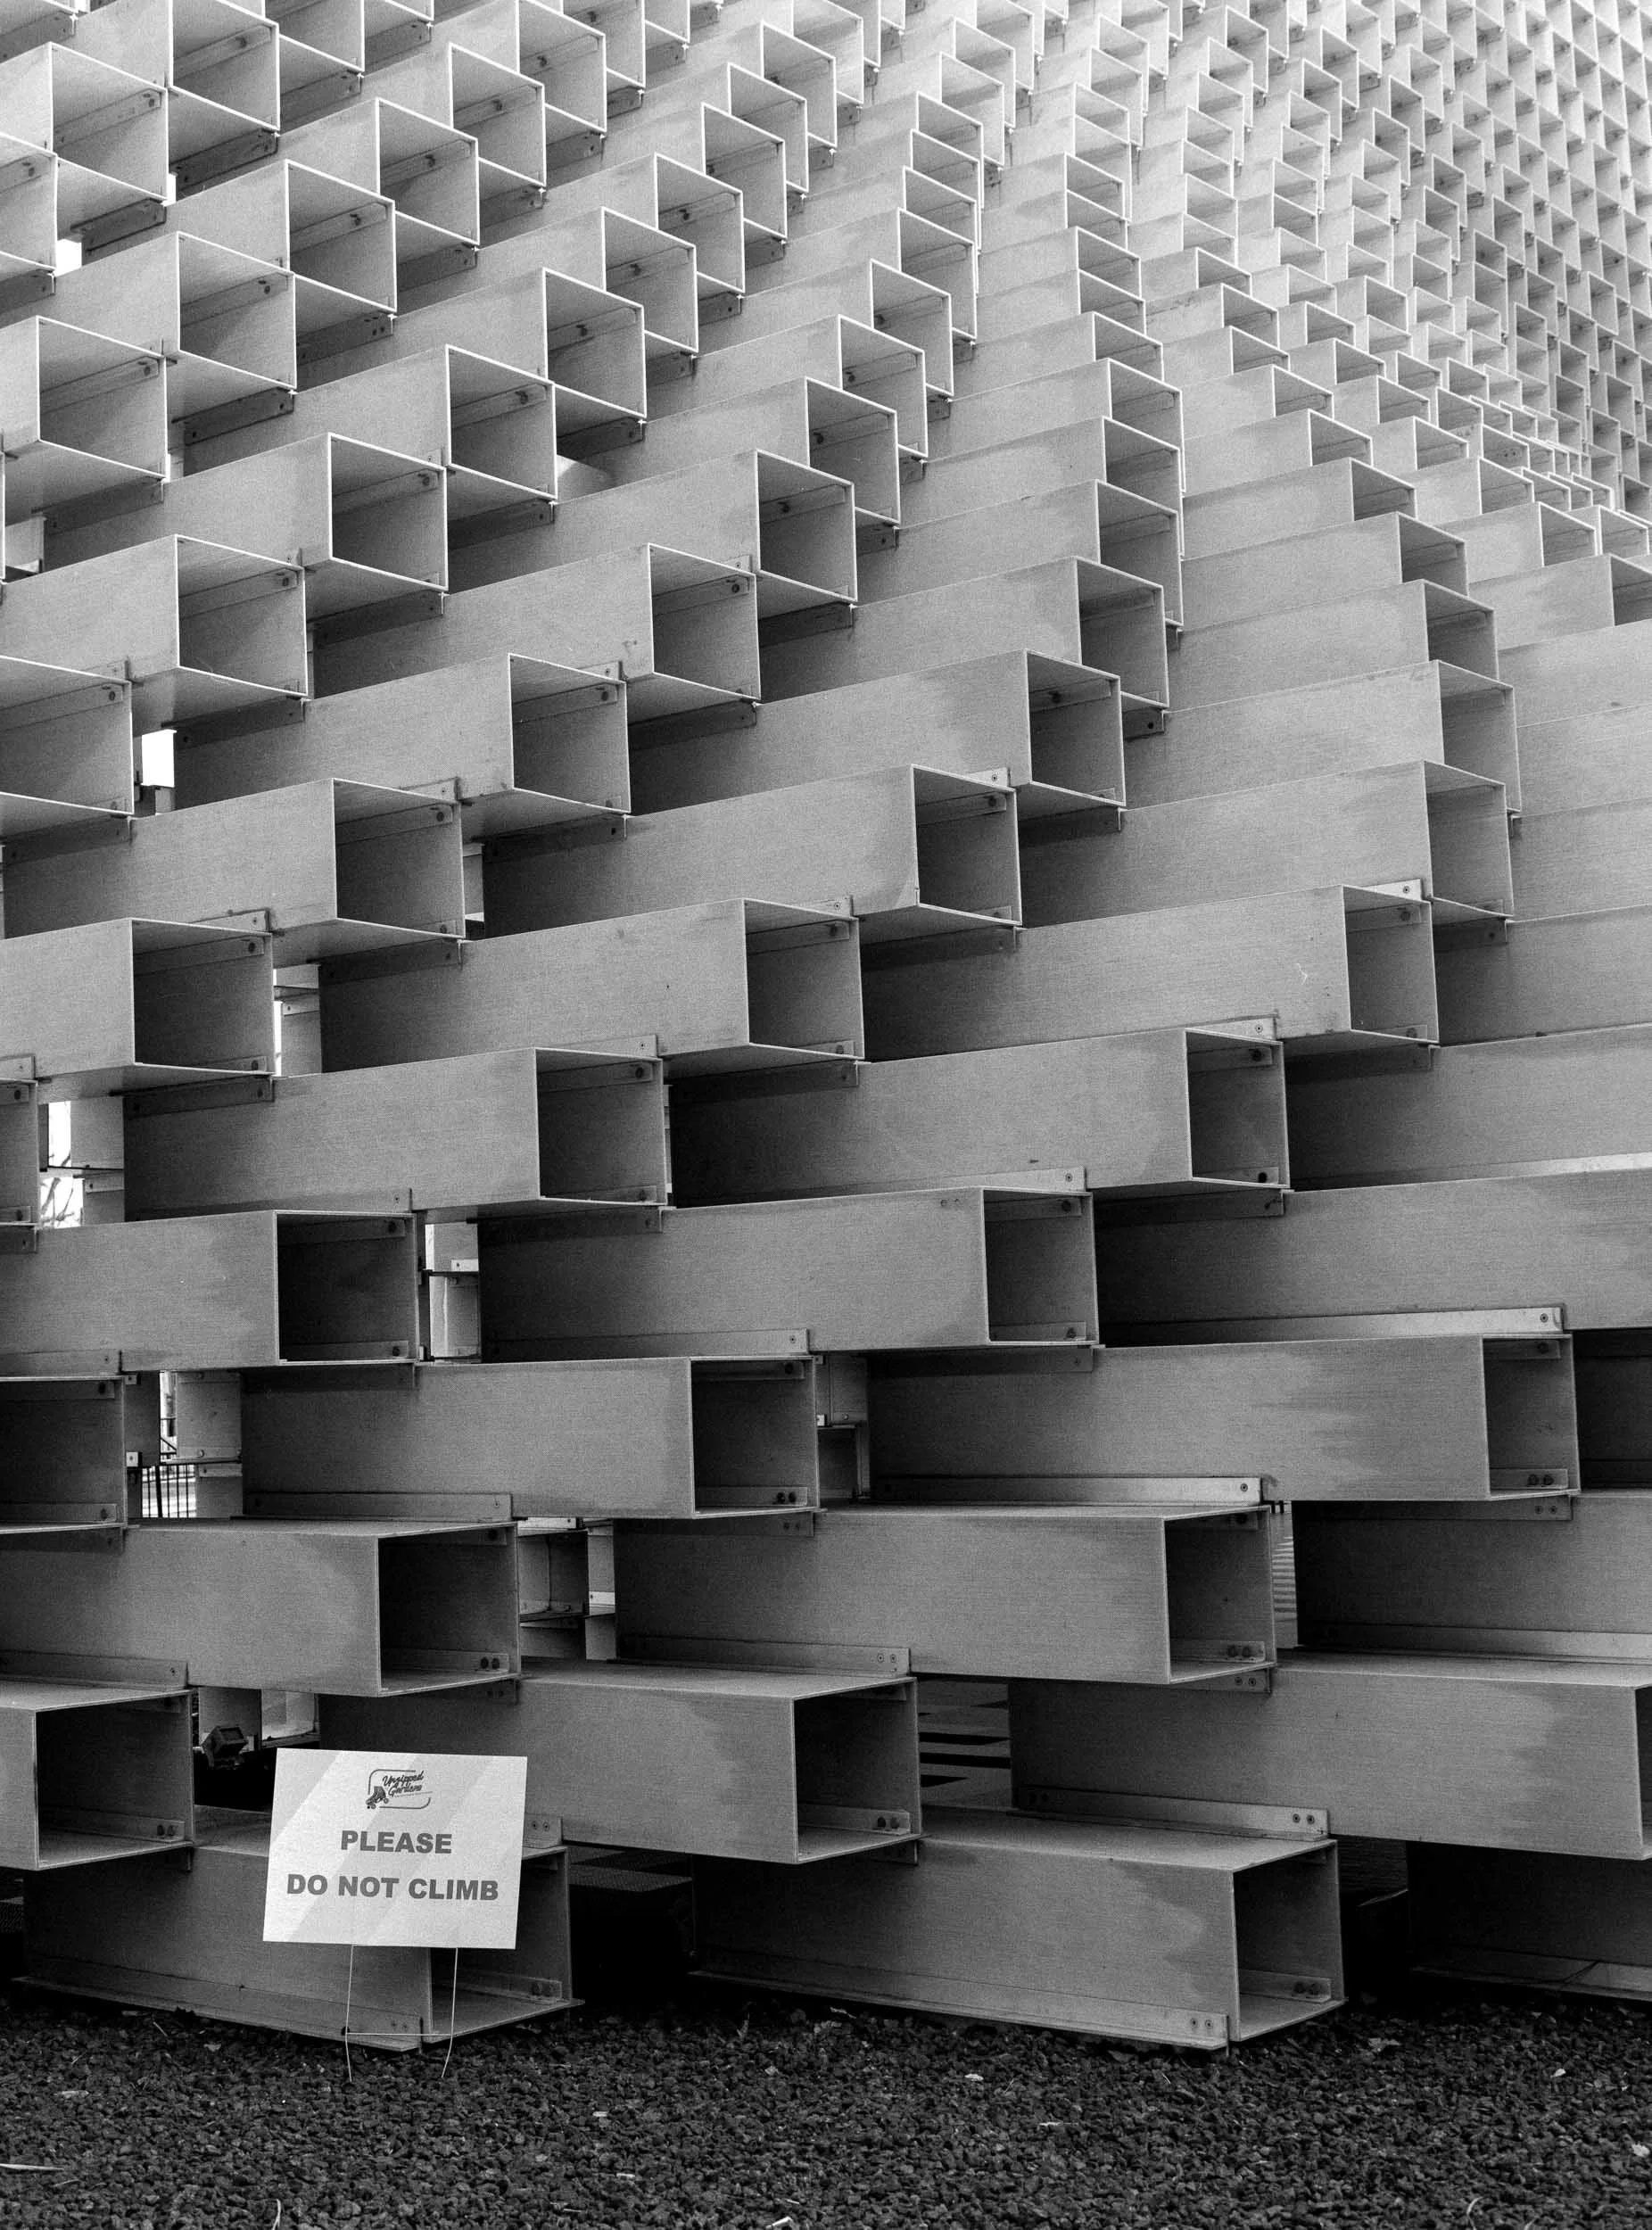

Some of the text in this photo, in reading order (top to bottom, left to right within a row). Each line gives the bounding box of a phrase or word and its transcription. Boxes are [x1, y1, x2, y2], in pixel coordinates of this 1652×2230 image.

[341, 1830, 452, 1854] PLEASE
[287, 1874, 499, 1901] DO NOT CLIMB
